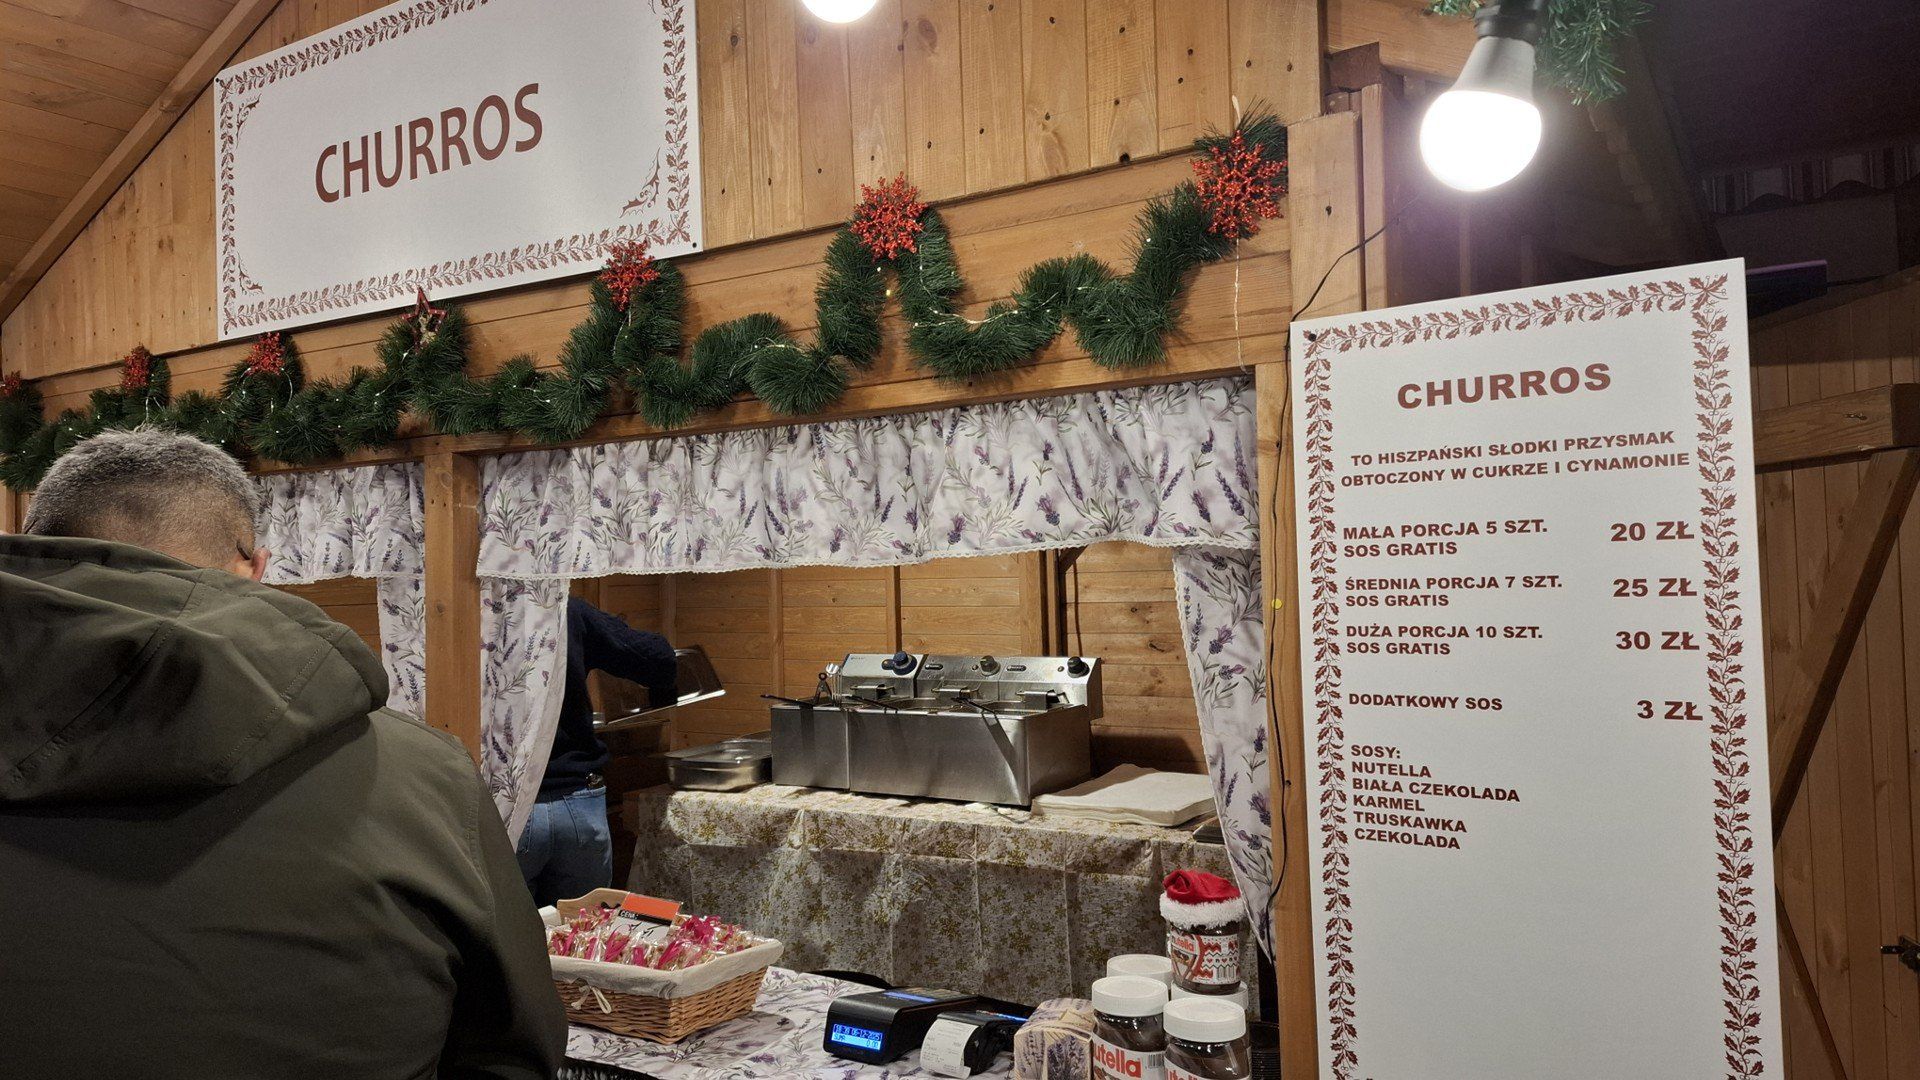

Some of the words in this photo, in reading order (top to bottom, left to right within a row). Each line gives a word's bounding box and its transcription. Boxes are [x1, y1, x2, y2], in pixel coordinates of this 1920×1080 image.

[315, 82, 543, 204] CHURROS
[1397, 362, 1611, 410] CHURROS
[1350, 454, 1373, 467] TO
[1377, 445, 1482, 465] HISZPAŃSKI
[1488, 439, 1558, 457] SŁODKI
[1563, 430, 1675, 452] PRZYSMAK
[1340, 468, 1446, 488] OBTOCZONY
[1450, 467, 1467, 480] W
[1472, 462, 1549, 479] CUKRZE
[1554, 461, 1561, 474] I
[1566, 452, 1690, 473] CYNAMONIE
[1343, 525, 1396, 540] MAŁA
[1400, 521, 1480, 538] PORCJA
[1485, 520, 1498, 535] 5
[1504, 518, 1548, 534] SZT.
[1610, 522, 1646, 542] 20
[1655, 520, 1695, 541] ZŁ
[1343, 544, 1381, 558] SOS
[1386, 541, 1458, 557] GRATIS
[1344, 576, 1421, 591] ŚREDNIA
[1426, 576, 1500, 590] PORCJA
[1504, 575, 1516, 589] 7
[1522, 574, 1563, 589] SZT.
[1612, 578, 1649, 598] 25
[1658, 577, 1698, 597] ZŁ
[1345, 594, 1380, 607] SOS
[1384, 594, 1450, 607] GRATIS
[1346, 622, 1393, 638] DUŻA
[1397, 625, 1470, 638] PORCJA
[1475, 625, 1498, 639] 10
[1502, 625, 1543, 639] SZT.
[1615, 630, 1651, 651] 30
[1660, 631, 1700, 651] ZŁ
[1346, 641, 1381, 655] SOS
[1385, 642, 1451, 656] GRATIS
[1348, 693, 1460, 710] DODATKOWY
[1465, 696, 1503, 711] SOS
[1636, 699, 1654, 720] 3
[1663, 700, 1703, 722] ZŁ
[1350, 744, 1401, 760] SOSY:
[1351, 760, 1432, 779] NUTELLA
[1352, 777, 1404, 794] BIAŁA
[1408, 781, 1521, 803] CZEKOLADA
[1353, 794, 1426, 812] KARMEL
[1352, 810, 1468, 834] TRUSKAWKA
[1354, 827, 1461, 850] CZEKOLADA
[1094, 1043, 1142, 1078] utella
